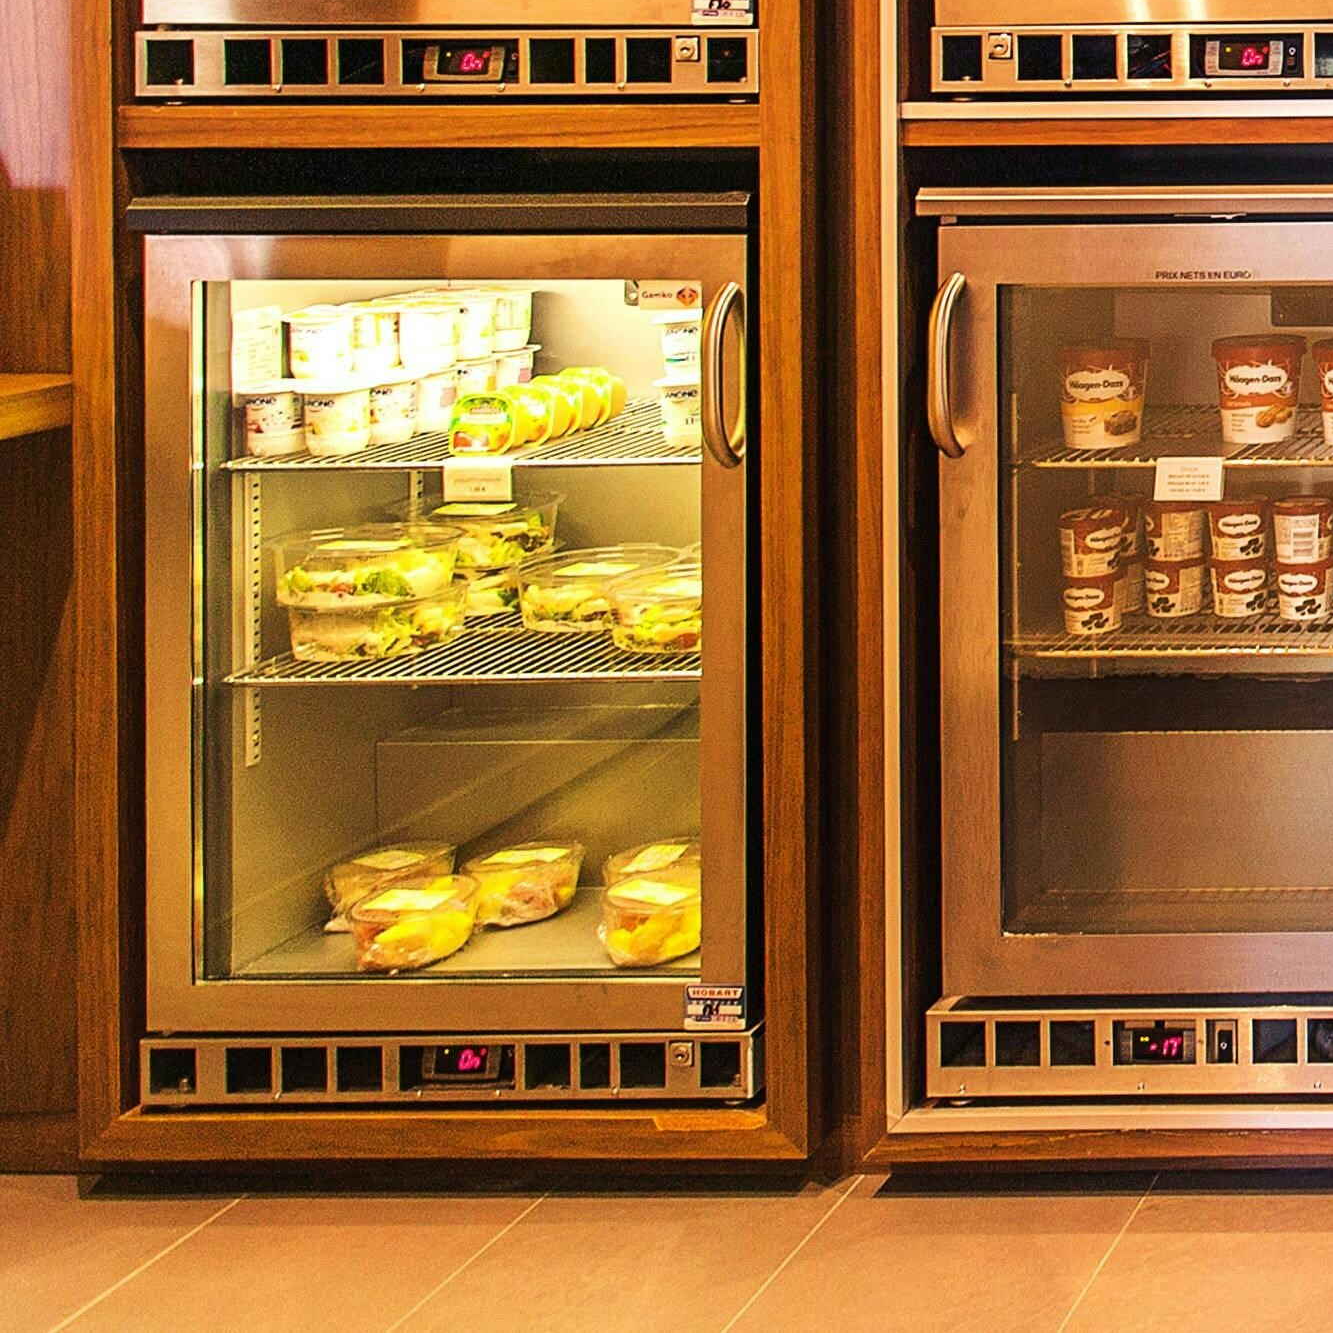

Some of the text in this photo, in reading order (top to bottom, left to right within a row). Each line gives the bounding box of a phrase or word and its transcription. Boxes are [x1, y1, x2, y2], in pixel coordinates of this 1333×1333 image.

[1155, 270, 1252, 280] PRIX NETS EN EURO
[692, 988, 739, 997] HOBART
